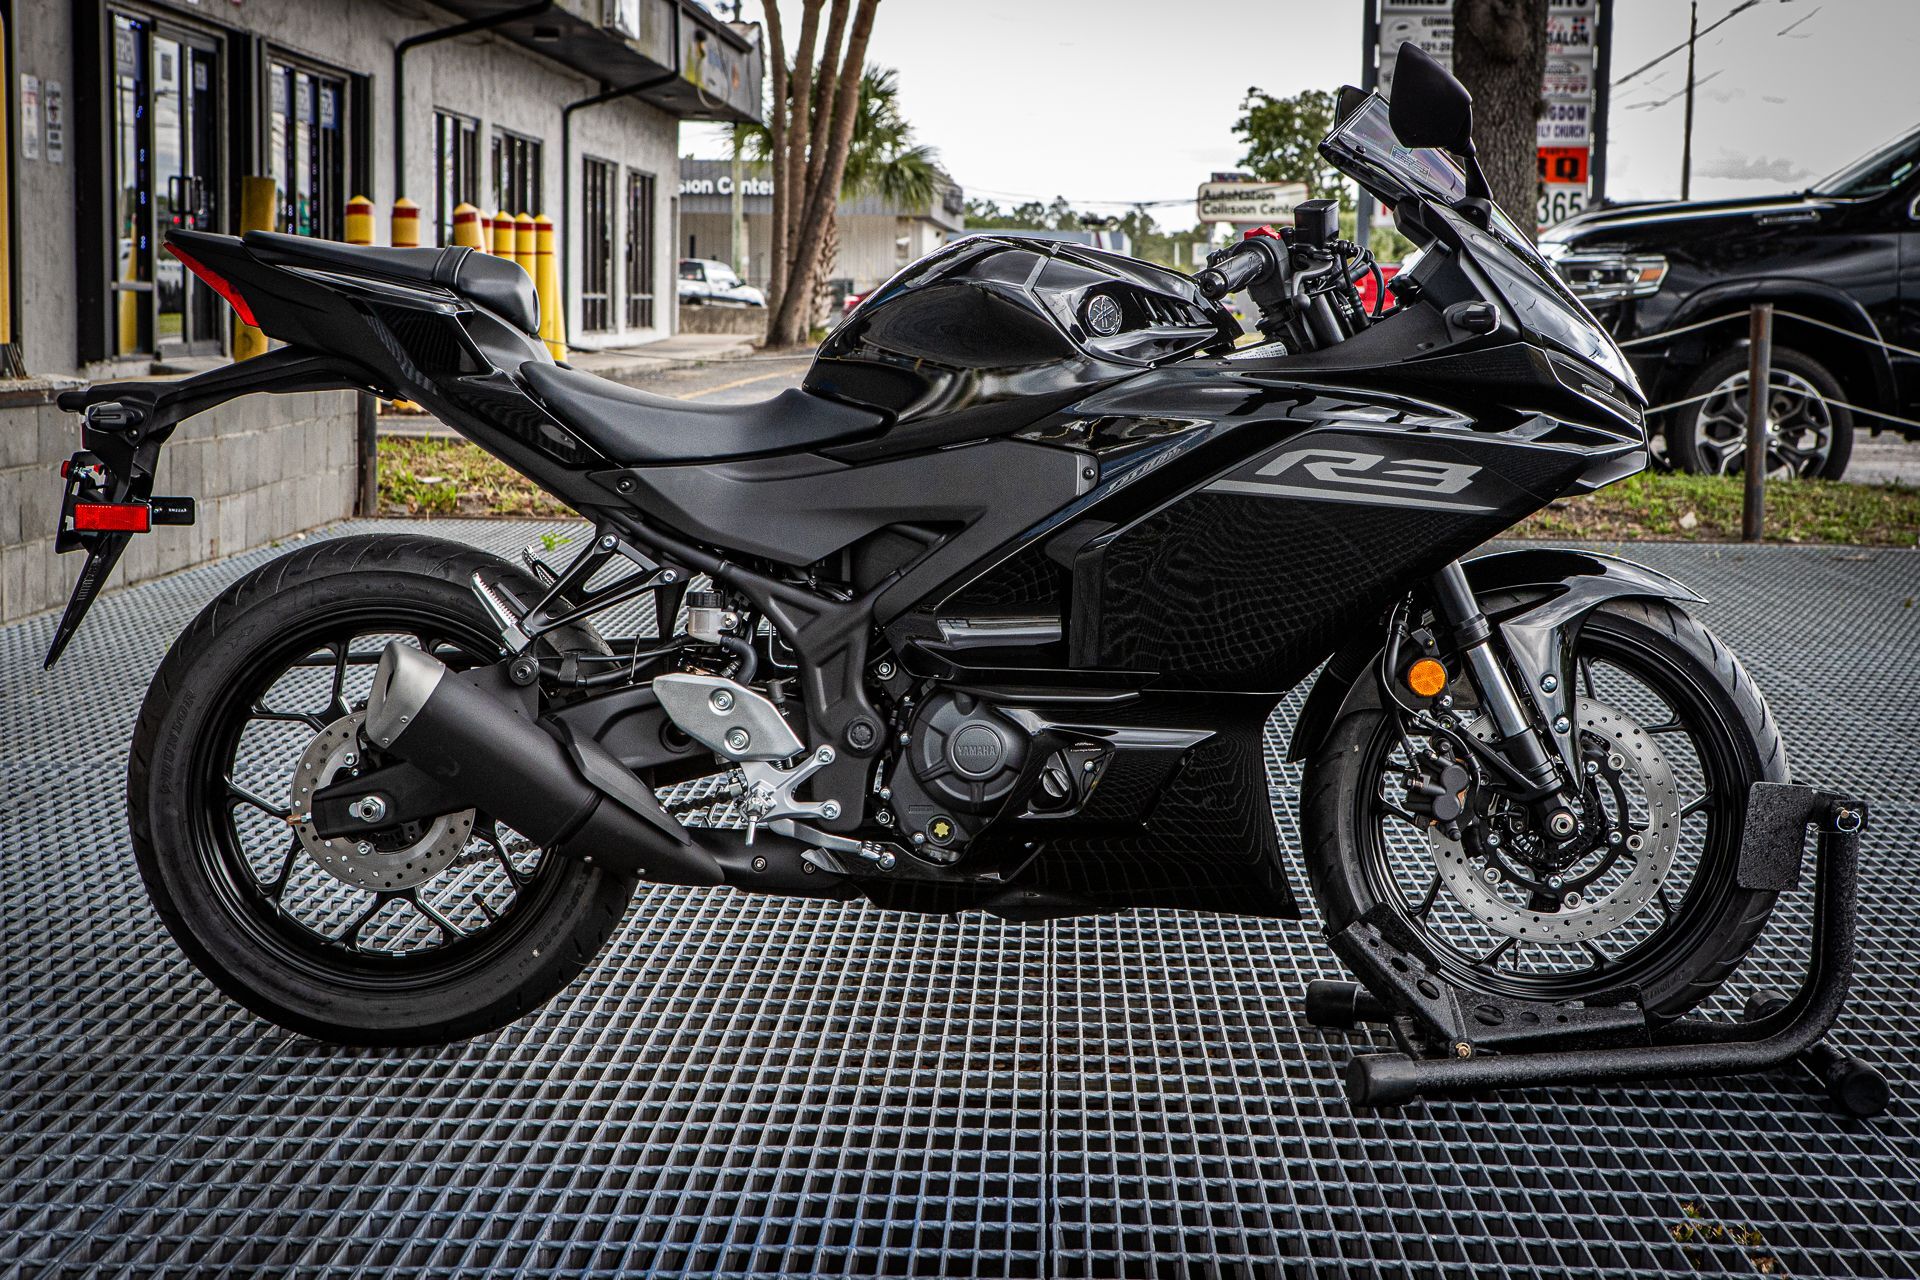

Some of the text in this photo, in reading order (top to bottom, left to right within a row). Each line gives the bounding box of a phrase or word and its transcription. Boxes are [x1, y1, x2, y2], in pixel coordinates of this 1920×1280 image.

[1203, 188, 1276, 201] AutoNation
[1202, 203, 1257, 215] Collision
[1255, 449, 1483, 494] R3
[957, 744, 997, 756] YAMAHA
